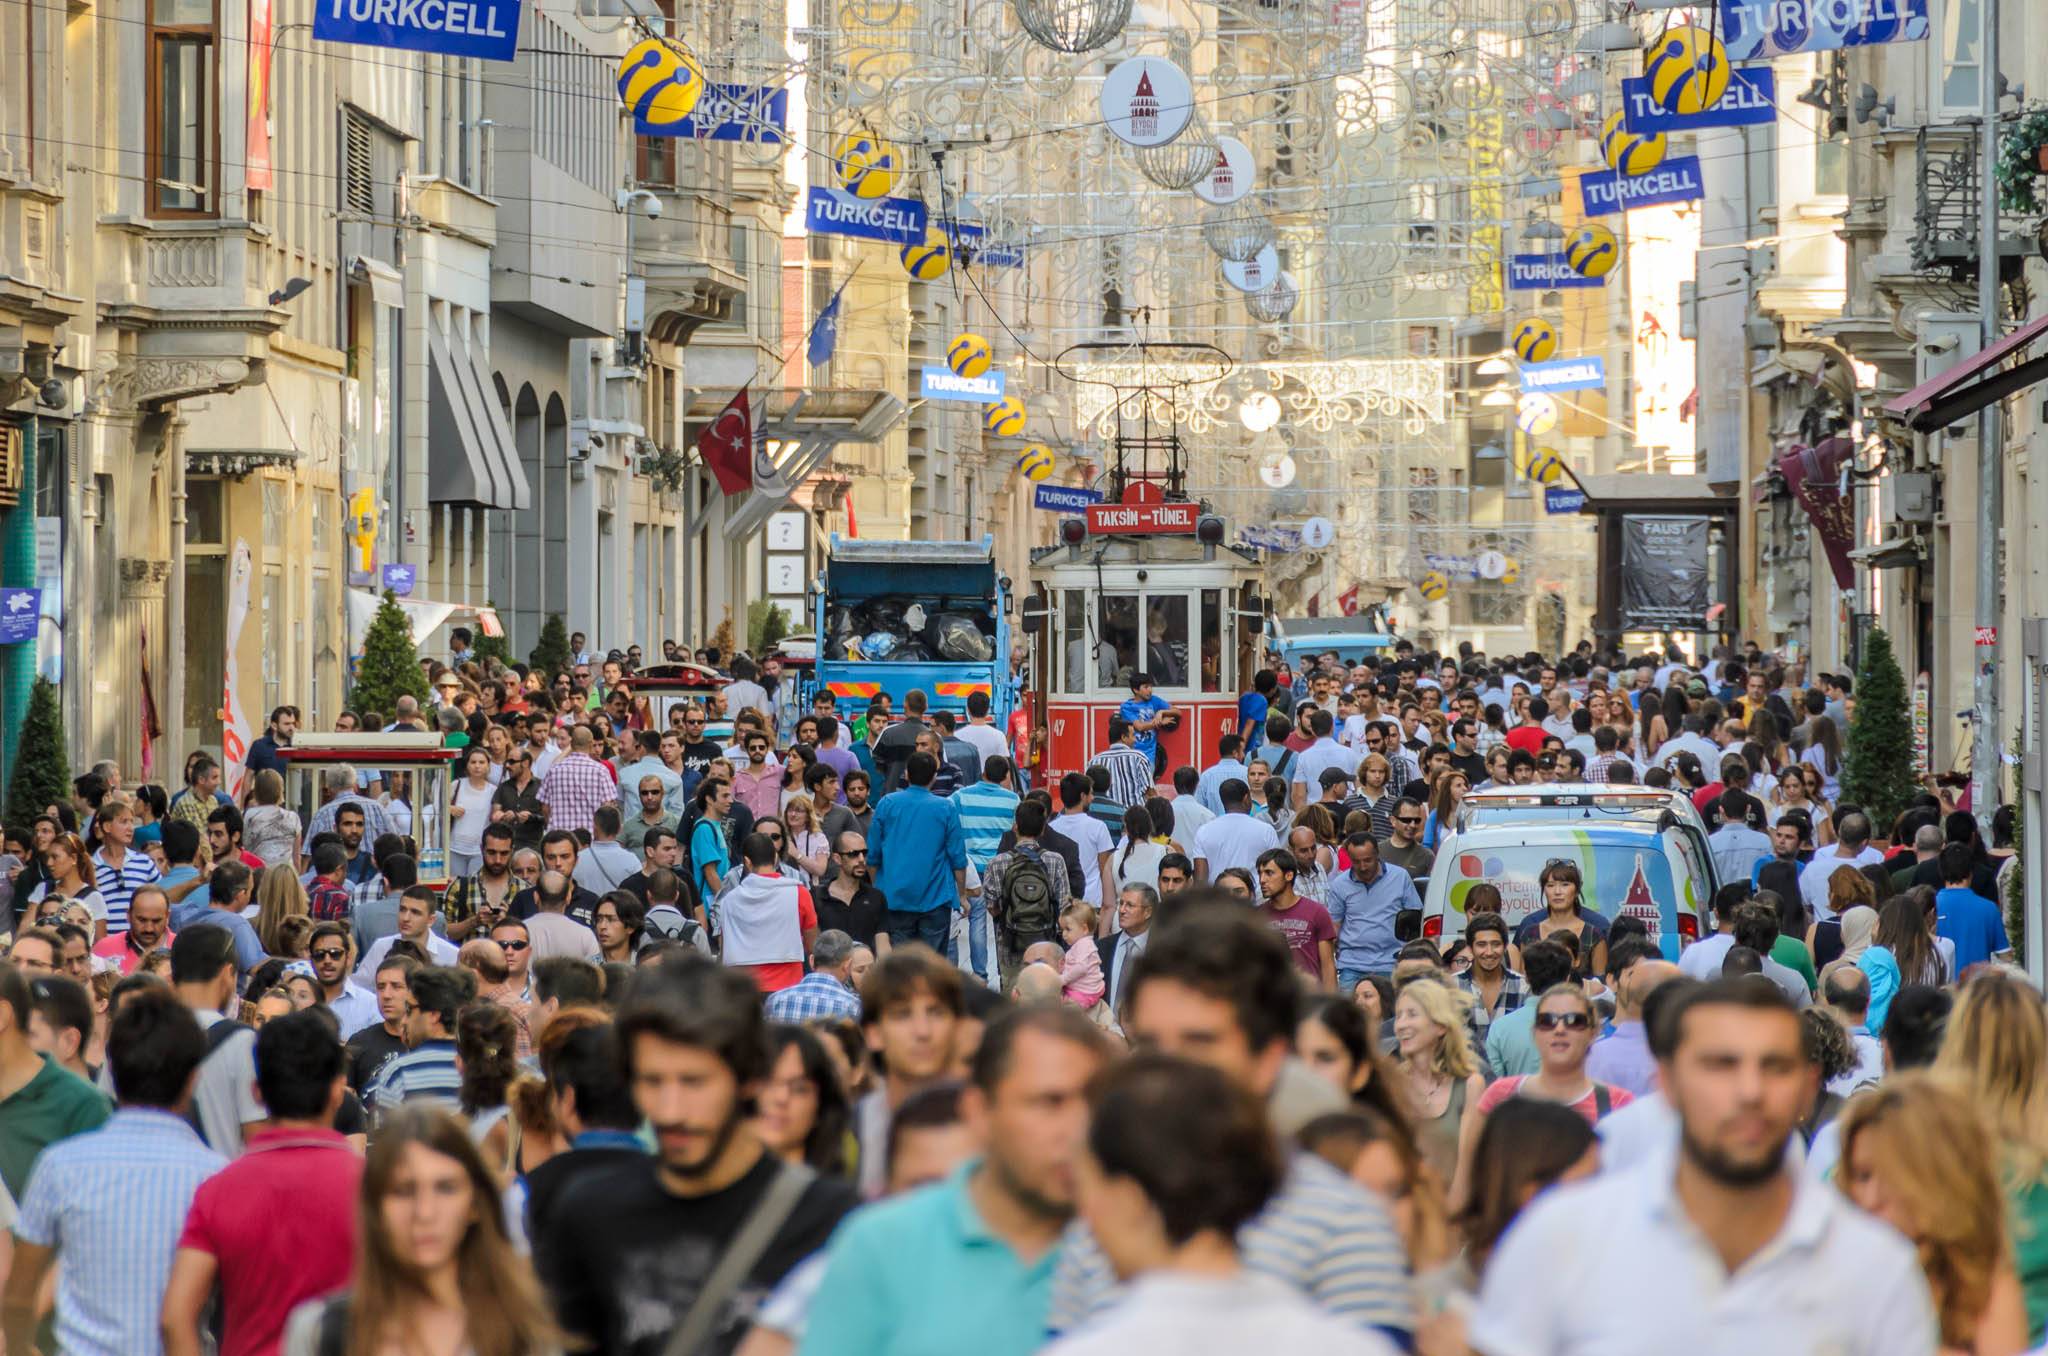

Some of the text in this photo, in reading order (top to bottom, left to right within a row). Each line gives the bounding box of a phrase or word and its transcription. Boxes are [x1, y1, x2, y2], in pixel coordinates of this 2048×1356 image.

[332, 0, 506, 38] TURKCELL
[1632, 84, 1769, 117] TUELL
[1586, 169, 1697, 204] TURKCELL
[812, 198, 920, 232] TURKCELL
[1139, 483, 1145, 502] 1
[1643, 523, 1688, 534] FAUST
[1053, 719, 1066, 737] 47
[1220, 718, 1232, 736] 47
